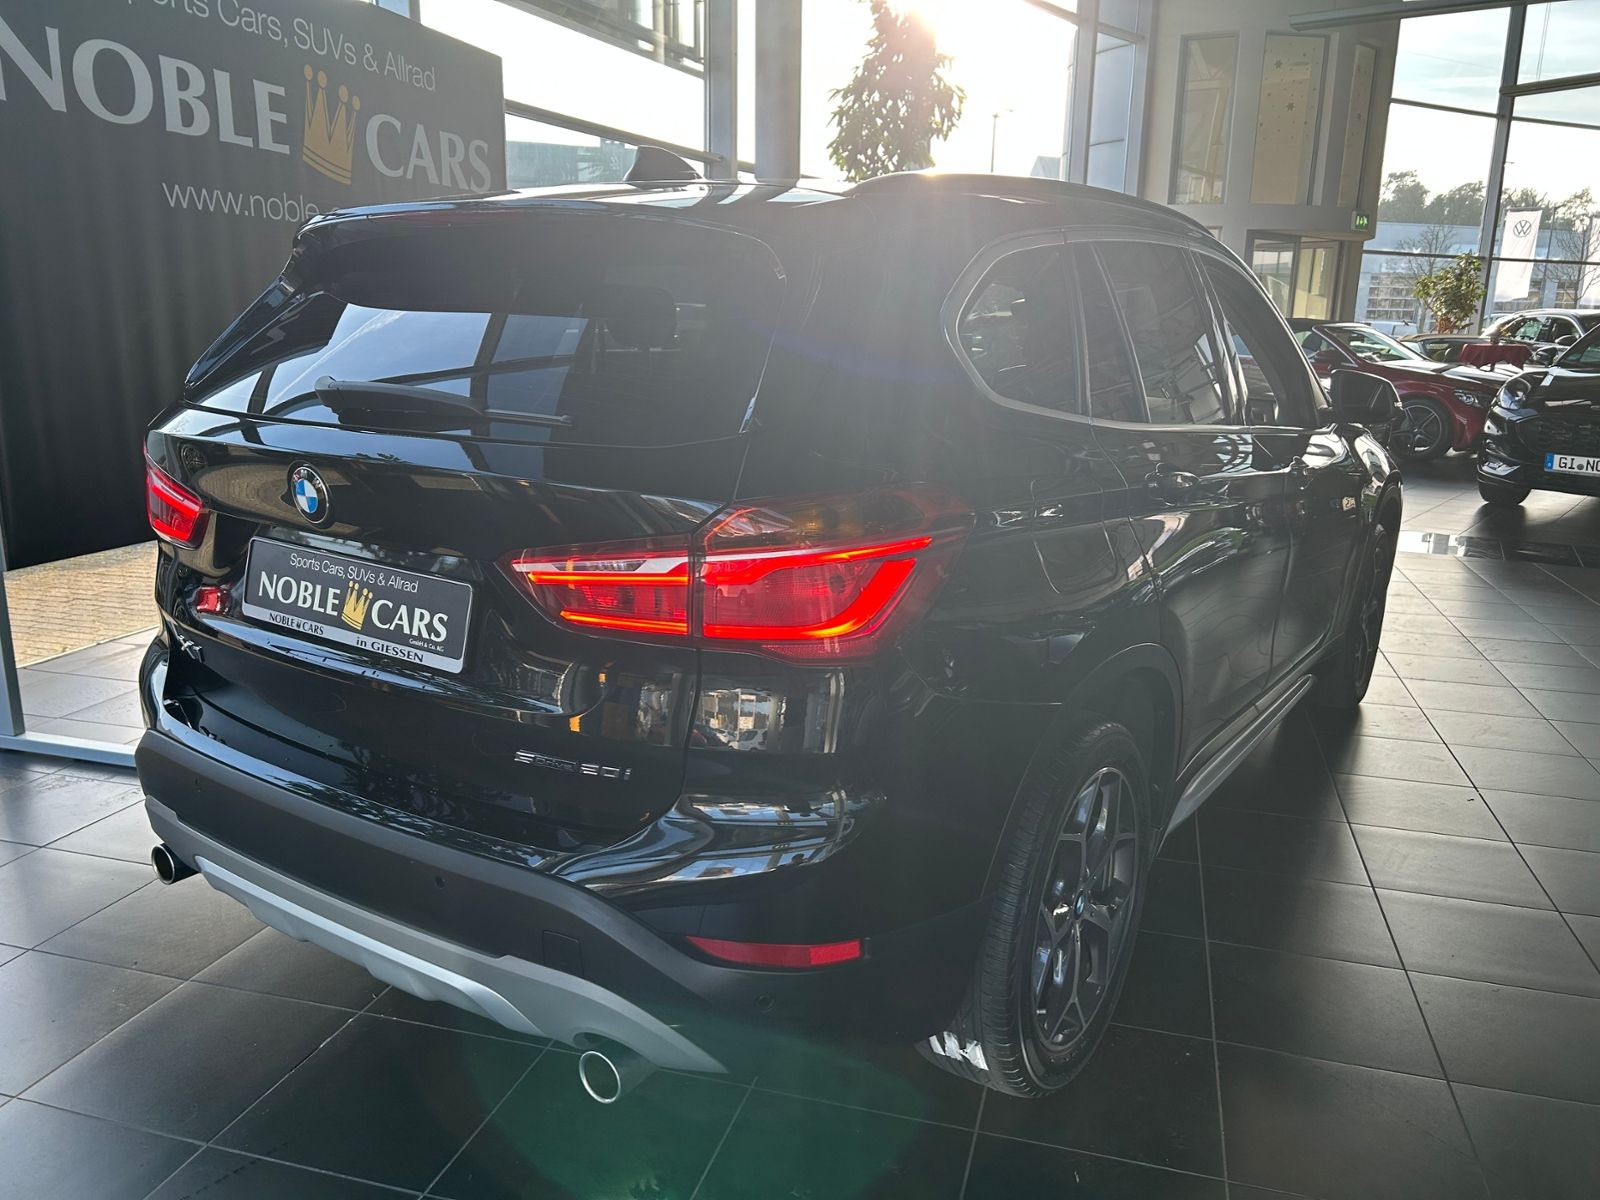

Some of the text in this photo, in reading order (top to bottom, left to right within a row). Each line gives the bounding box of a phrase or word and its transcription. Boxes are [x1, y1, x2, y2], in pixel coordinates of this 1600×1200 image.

[217, 0, 288, 48] Cars,
[294, 18, 358, 66] SUVs
[363, 43, 381, 74] &
[383, 51, 437, 92] Allrad
[0, 16, 493, 194] NOBLE CARS
[162, 182, 340, 223] www.noble
[1558, 456, 1576, 470] GI
[290, 553, 419, 593] Sports Cars, SUVs & Allrad
[257, 570, 449, 643] NOBLE CARS
[269, 612, 325, 636] NOBLE CARS
[356, 636, 424, 663] in GIESSEN
